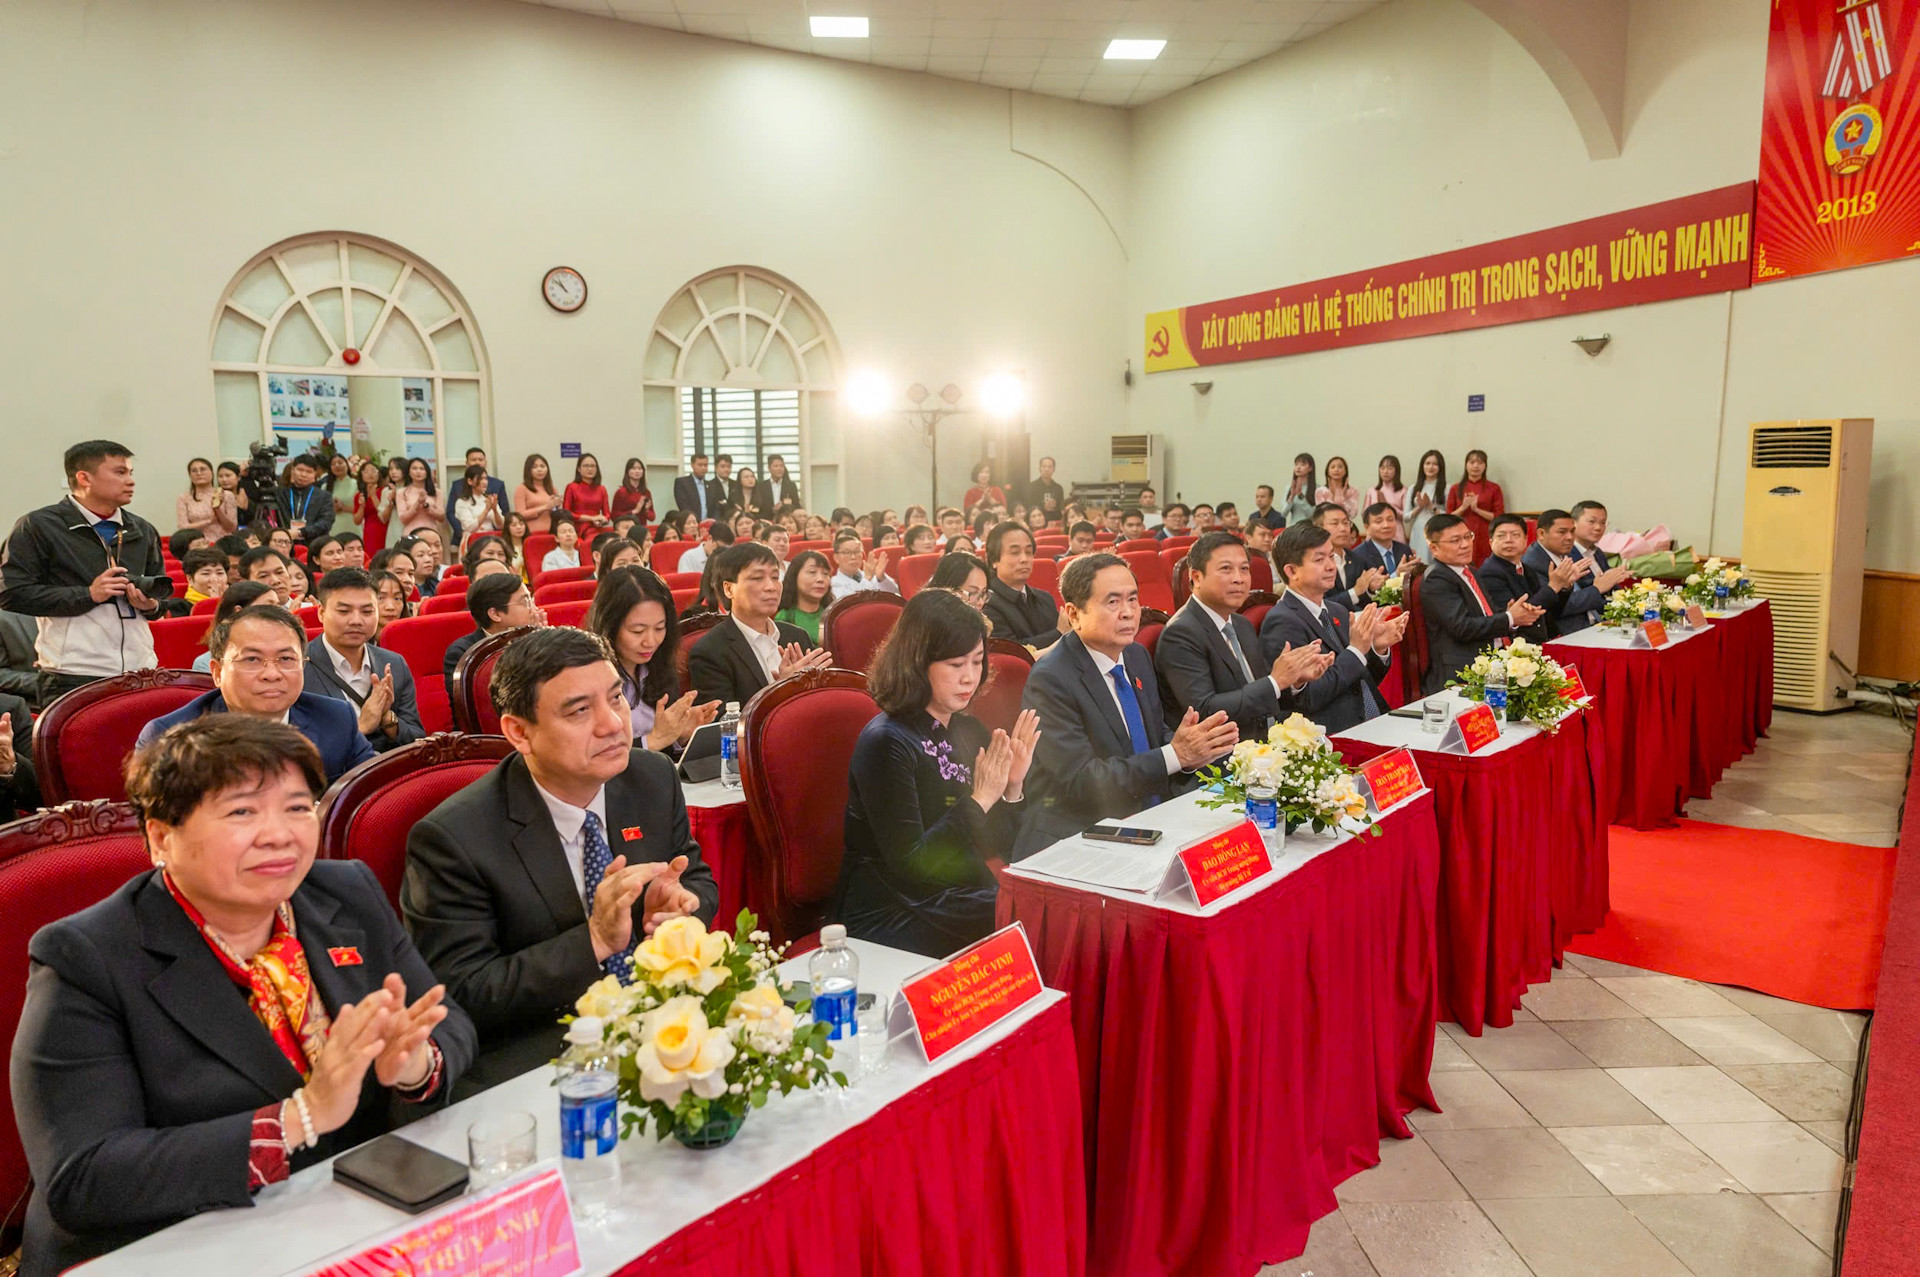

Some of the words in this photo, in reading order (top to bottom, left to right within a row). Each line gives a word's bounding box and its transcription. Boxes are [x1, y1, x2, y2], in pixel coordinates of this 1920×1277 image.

[1816, 191, 1877, 224] 2013
[1201, 313, 1226, 349] XÂY
[1228, 310, 1261, 351] DỰNG
[1264, 297, 1300, 340] ĐẢNG
[1303, 294, 1321, 333] VÀ
[1324, 289, 1342, 336] HỆ
[1345, 278, 1394, 327] THỐNG
[1397, 272, 1446, 319] CHÍNH
[1450, 269, 1477, 315] TRỊ
[1481, 257, 1540, 305] TRONG
[1545, 244, 1603, 301] SẠCH,
[1610, 228, 1668, 283] VỮNG
[1674, 213, 1749, 279] MẠNH
[990, 952, 1014, 971] VINH
